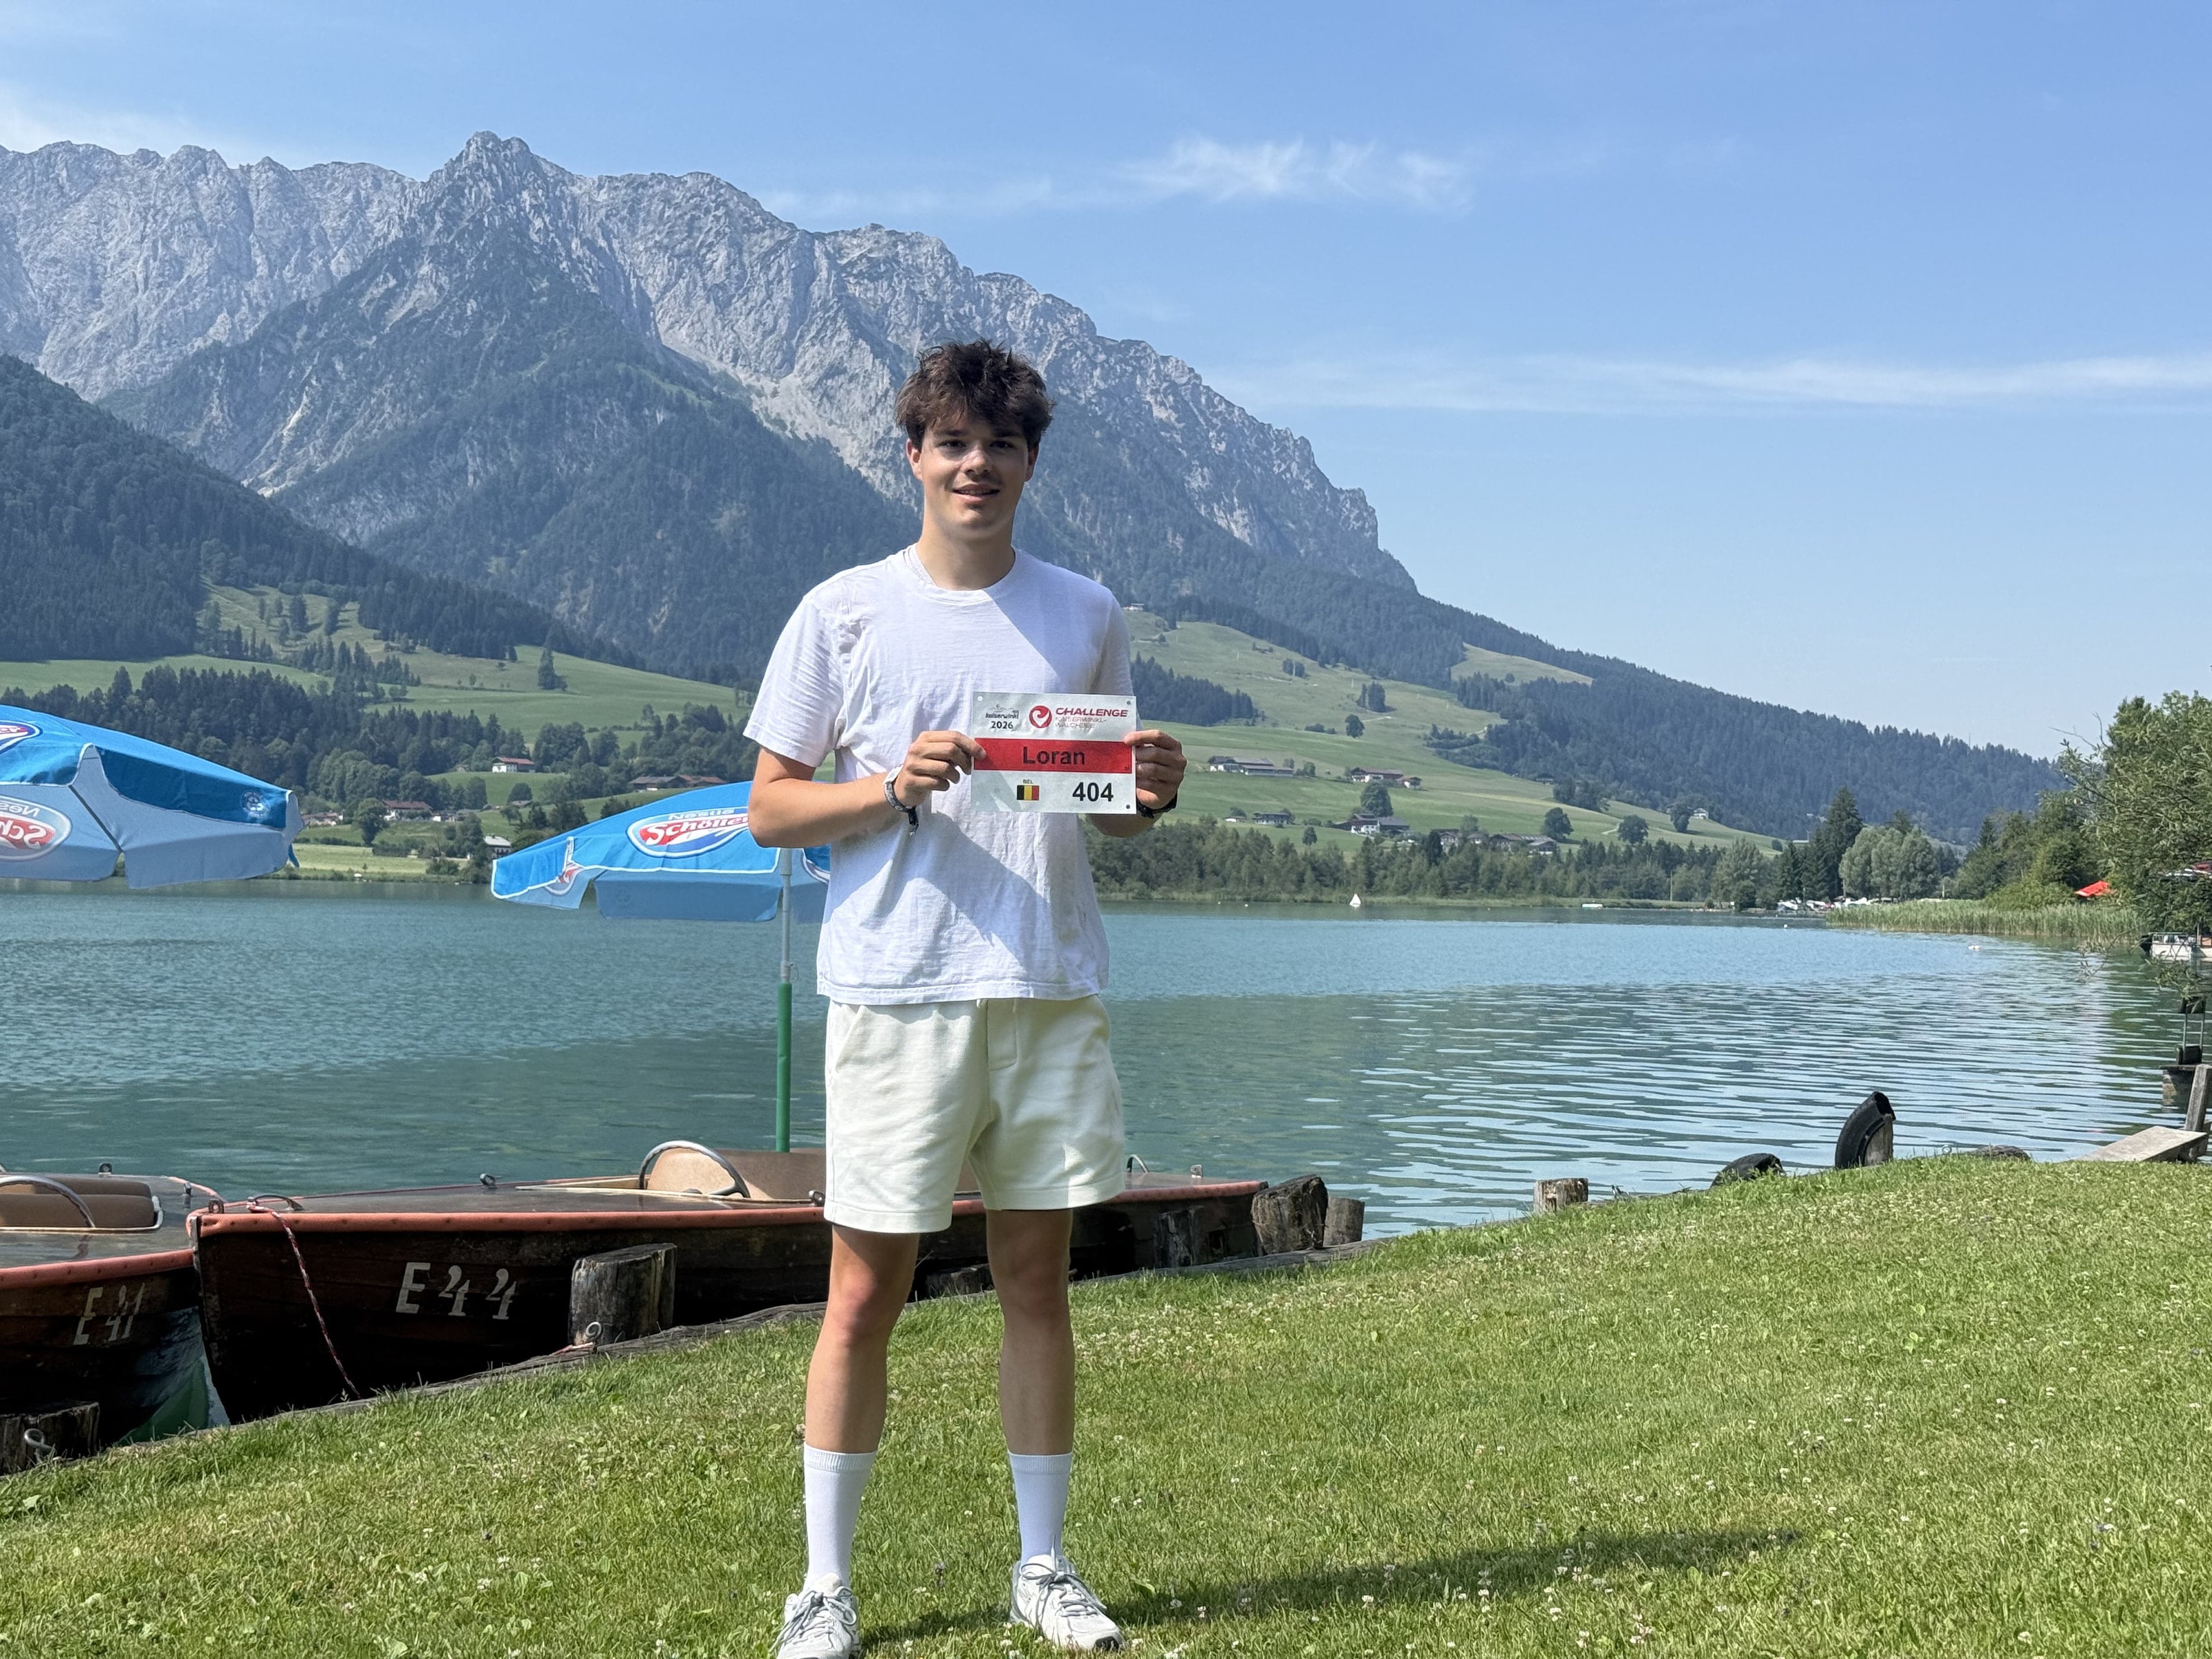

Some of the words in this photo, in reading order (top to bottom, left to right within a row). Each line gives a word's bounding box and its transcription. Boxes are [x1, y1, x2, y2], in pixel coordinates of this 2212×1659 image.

[1056, 707, 1129, 718] CHALLENGE
[991, 721, 1013, 729] 2026
[1022, 746, 1085, 765] Loran
[1072, 782, 1114, 802] 404
